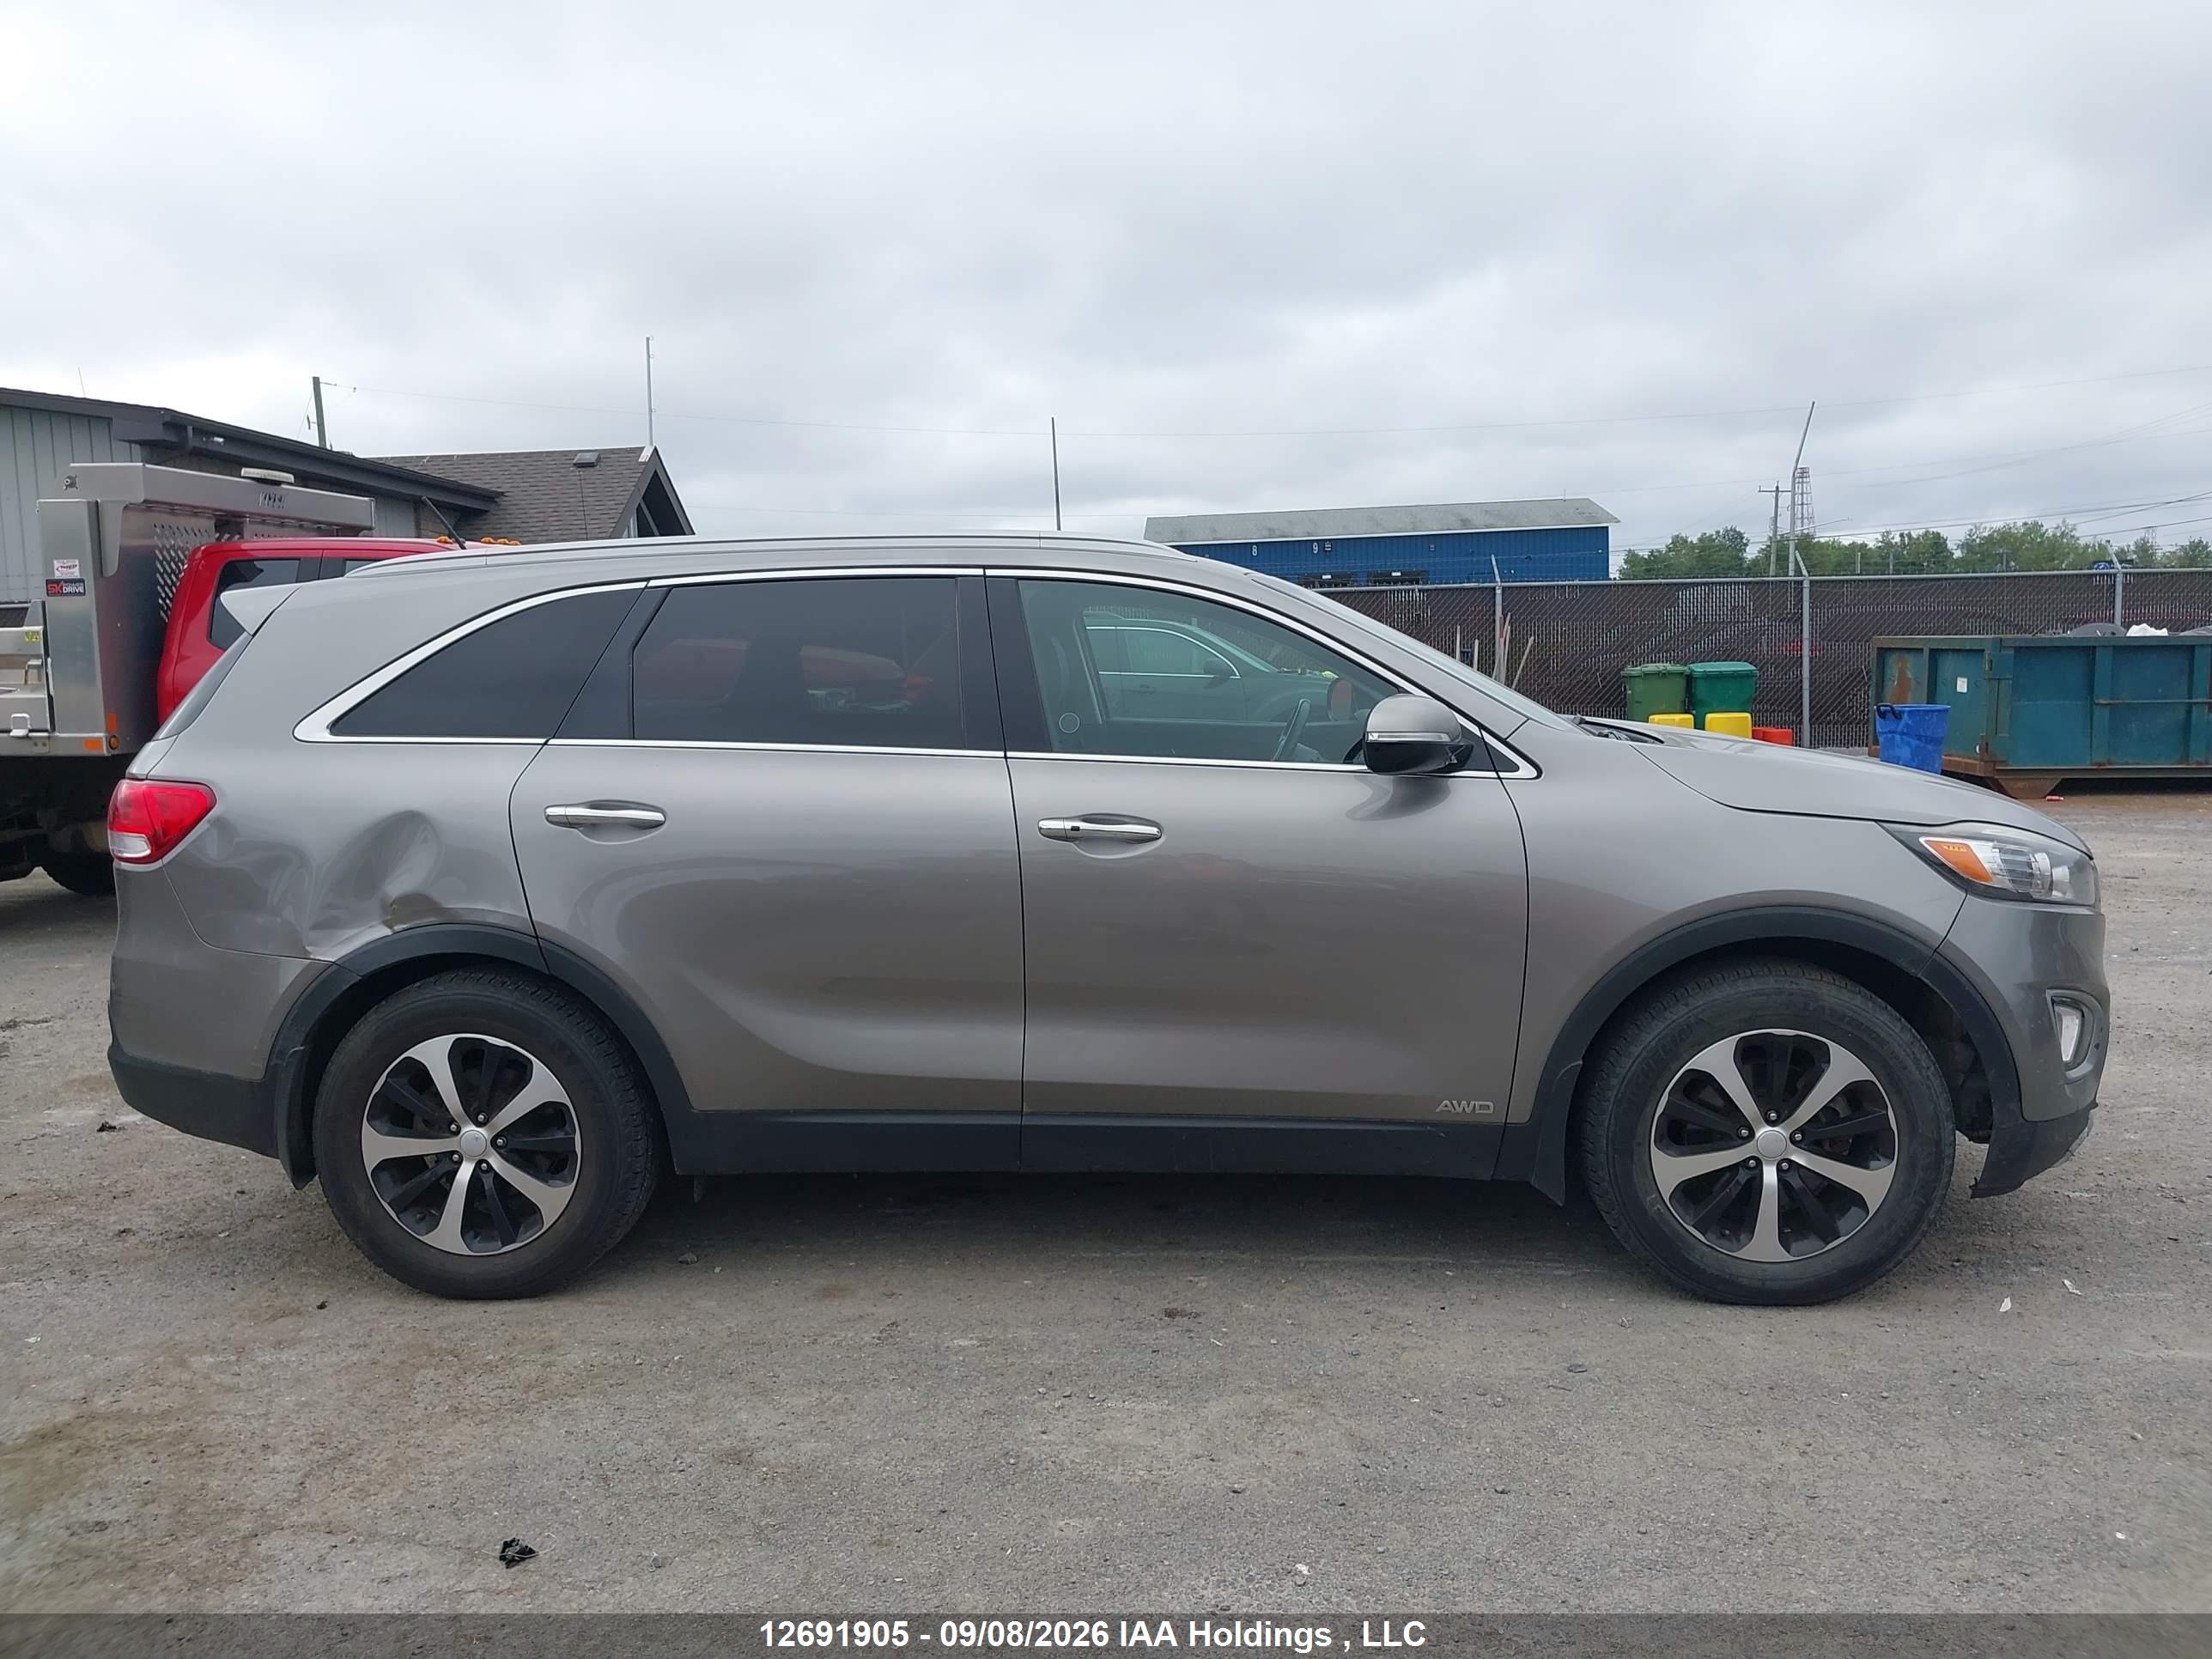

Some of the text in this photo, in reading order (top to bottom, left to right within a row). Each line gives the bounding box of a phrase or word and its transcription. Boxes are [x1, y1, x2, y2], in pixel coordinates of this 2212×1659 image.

[1252, 544, 1258, 556] 8
[1312, 542, 1319, 554] 9
[1435, 1100, 1494, 1114] AWD
